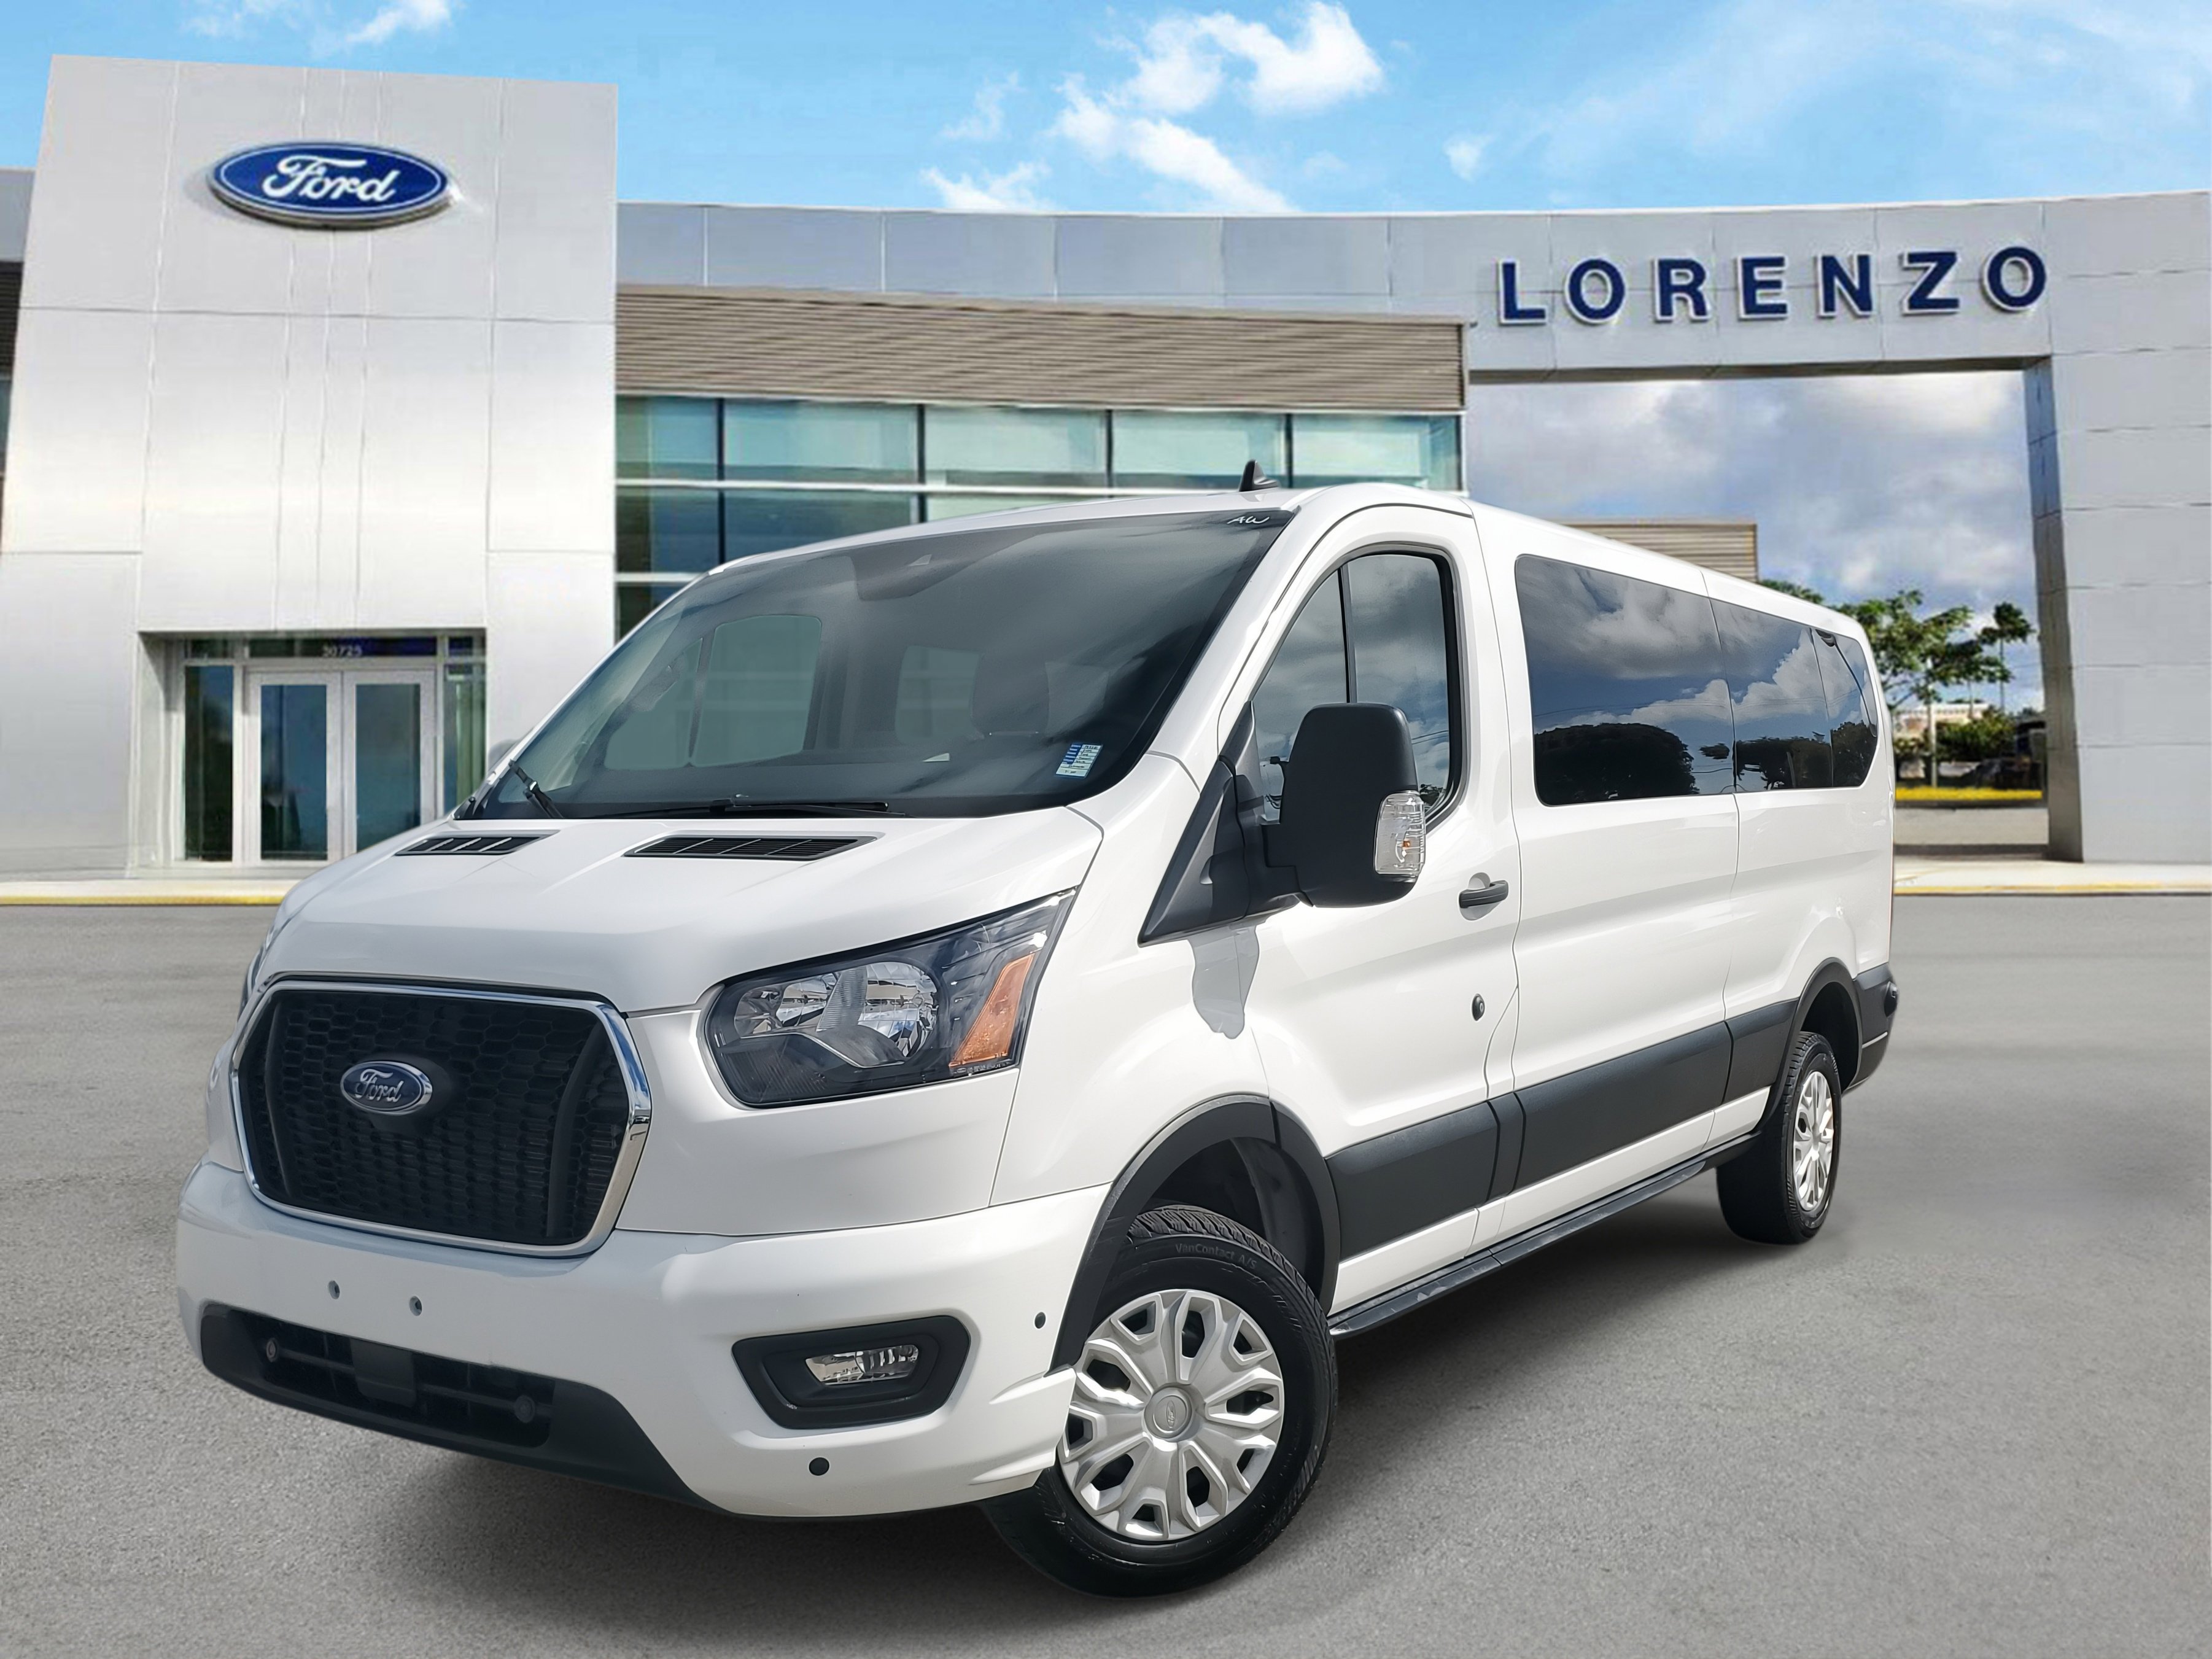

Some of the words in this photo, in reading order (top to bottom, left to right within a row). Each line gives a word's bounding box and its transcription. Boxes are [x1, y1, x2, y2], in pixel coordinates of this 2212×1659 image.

[262, 154, 400, 202] Ford
[1497, 246, 2047, 325] LORENZO
[355, 1068, 405, 1103] Ford
[1175, 1243, 1235, 1259] VanContact
[1238, 1254, 1257, 1270] A/S
